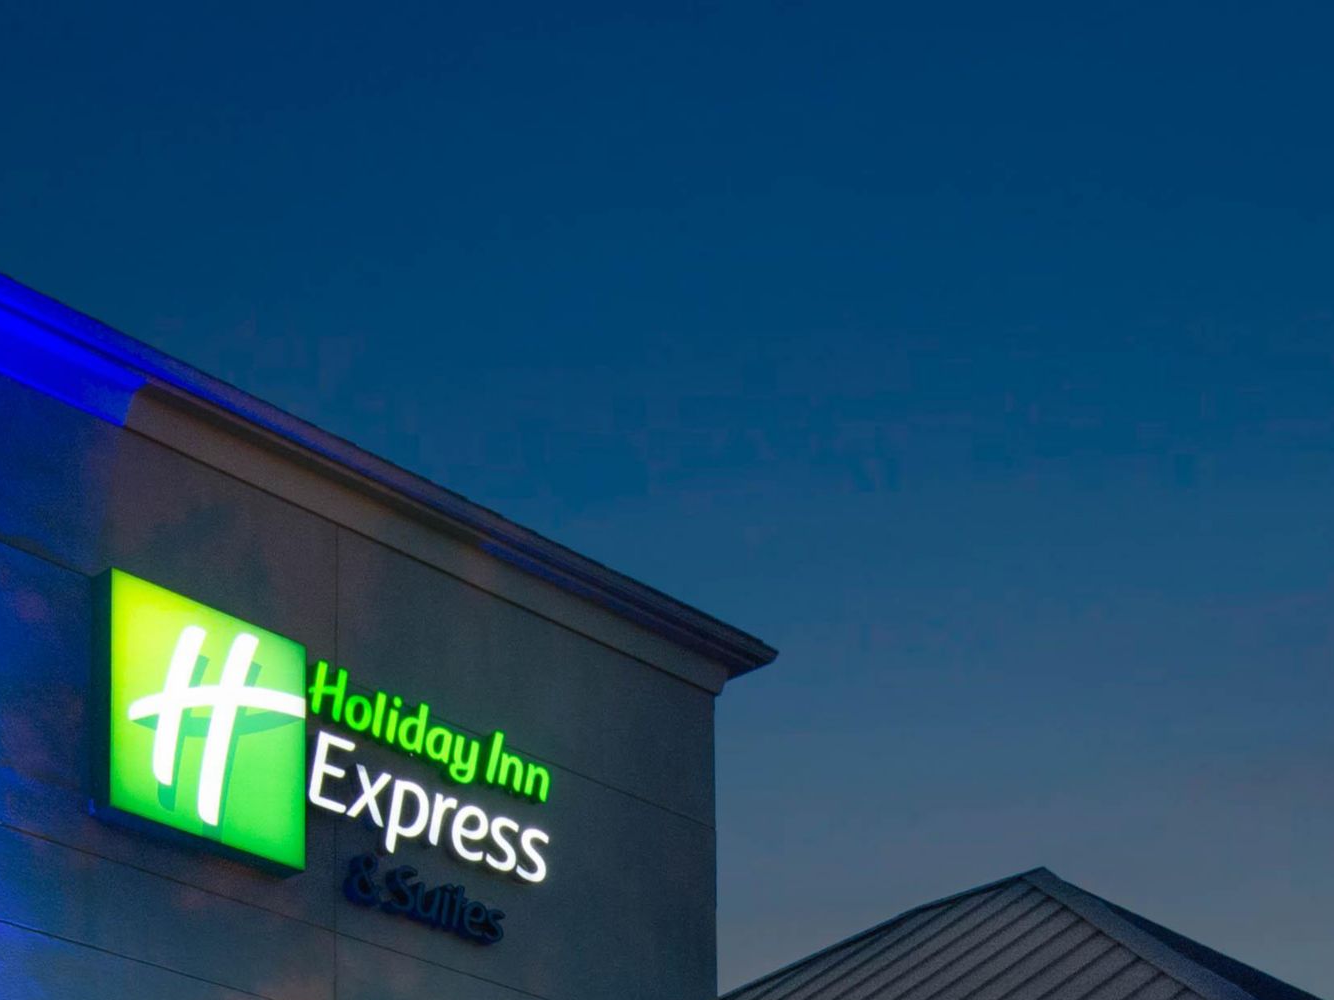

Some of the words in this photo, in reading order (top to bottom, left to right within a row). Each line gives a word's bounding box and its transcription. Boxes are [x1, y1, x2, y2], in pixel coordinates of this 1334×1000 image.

[309, 660, 479, 785] Holiday
[486, 731, 550, 802] Inn
[308, 730, 550, 882] Express
[344, 852, 380, 907] &
[381, 864, 506, 944] Suites
